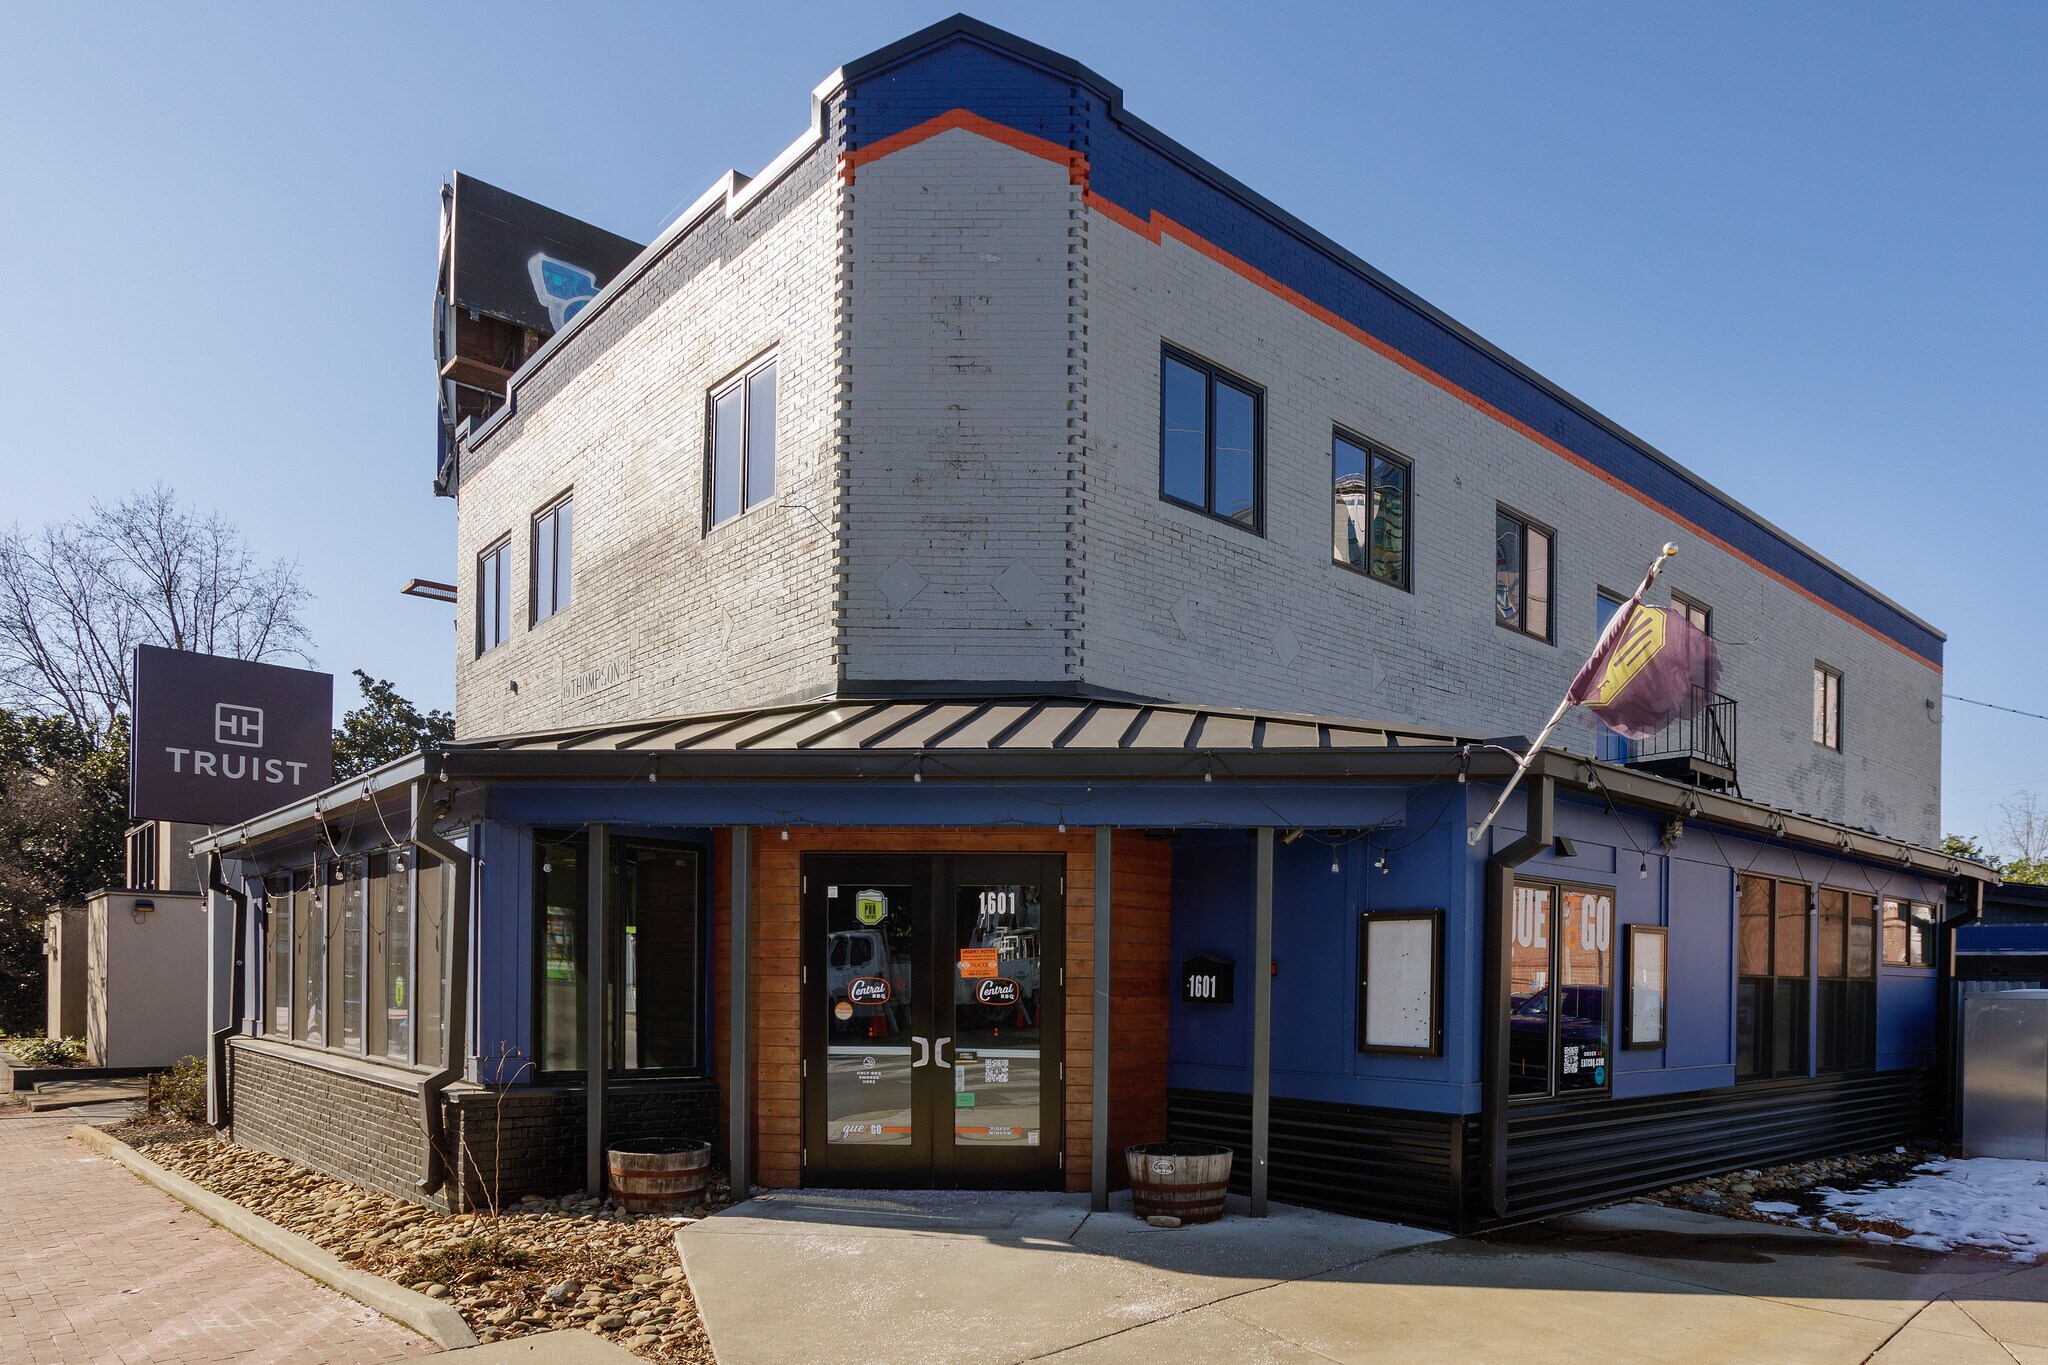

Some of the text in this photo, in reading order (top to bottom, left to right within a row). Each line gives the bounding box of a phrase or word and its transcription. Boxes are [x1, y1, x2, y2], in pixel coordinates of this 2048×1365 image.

[571, 658, 620, 698] THOMPSON
[165, 747, 308, 785] TRUIST
[864, 904, 877, 915] PUB
[979, 892, 1015, 915] 1601
[1512, 887, 1548, 950] UE
[1581, 895, 1611, 952] GO
[851, 980, 886, 1001] Central
[979, 980, 1014, 1001] Central
[1189, 974, 1216, 998] 1601
[843, 1124, 865, 1138] que
[870, 1124, 882, 1134] GO
